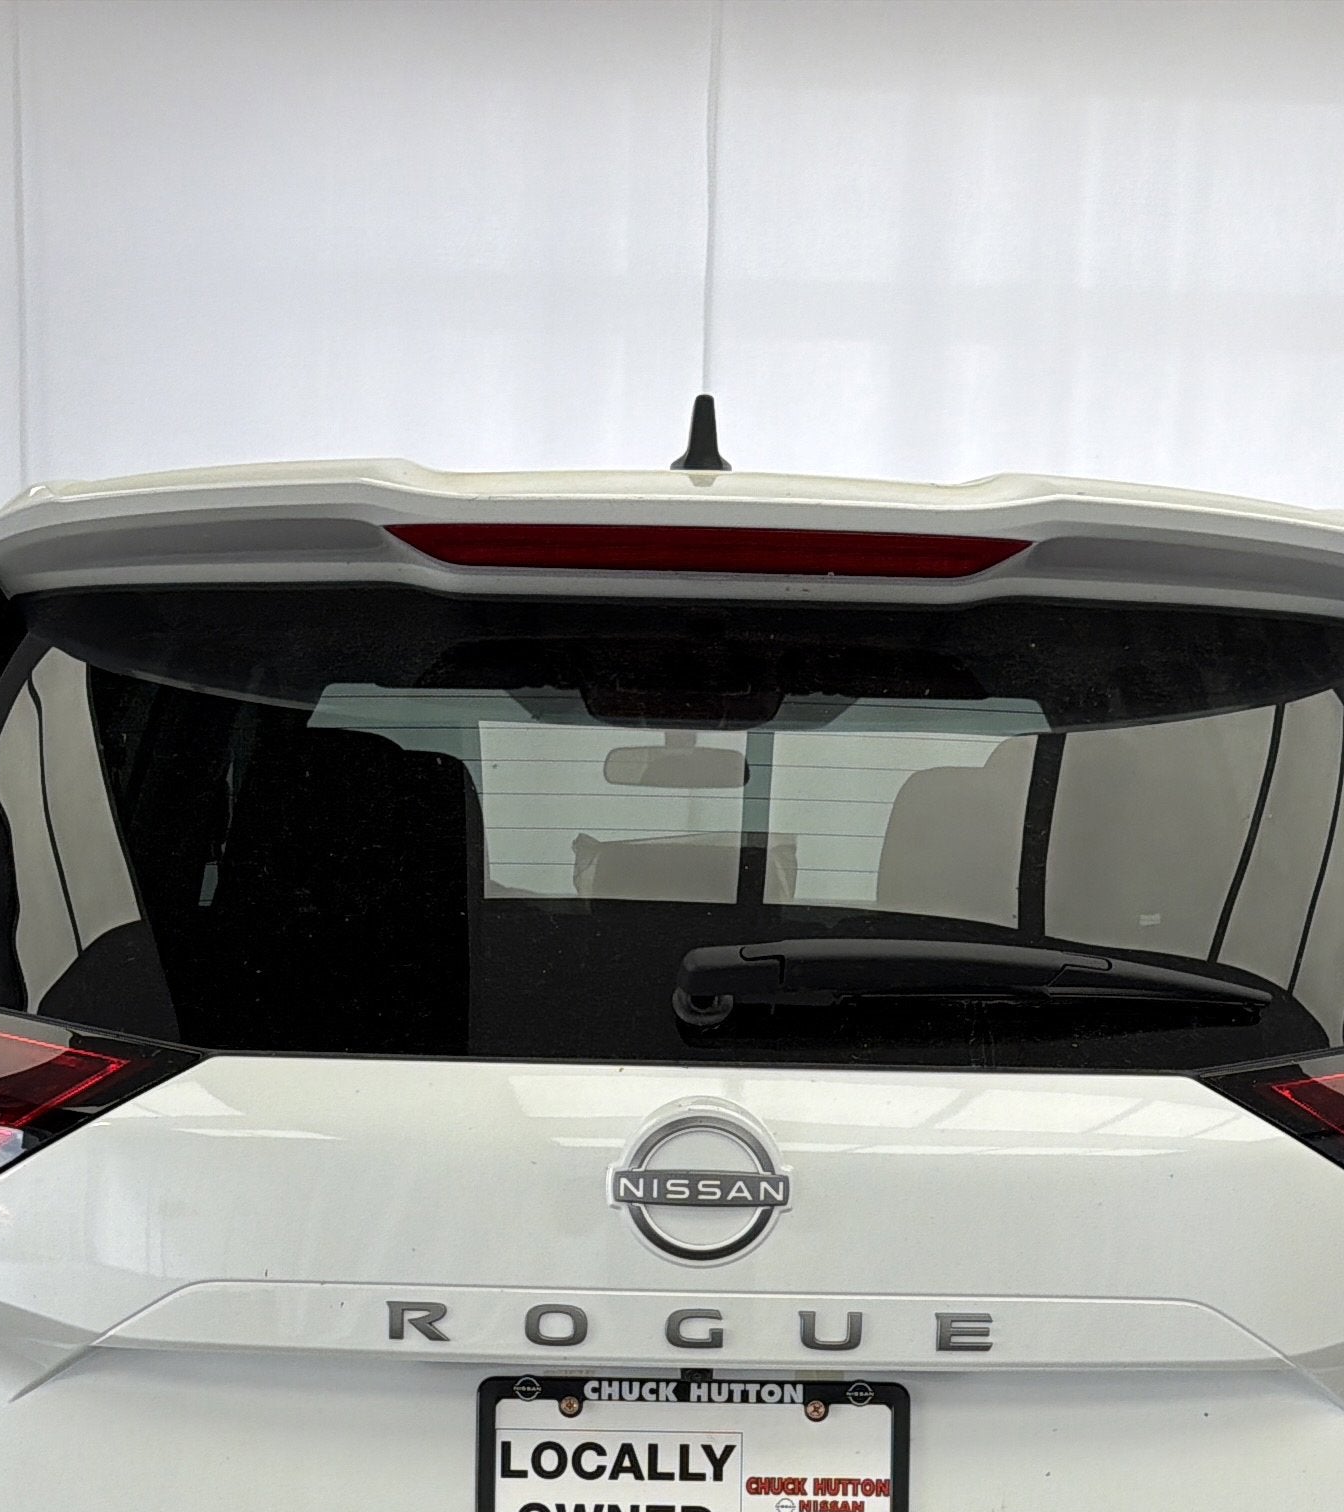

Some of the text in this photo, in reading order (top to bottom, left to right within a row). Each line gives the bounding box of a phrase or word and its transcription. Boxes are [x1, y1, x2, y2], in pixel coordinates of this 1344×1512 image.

[618, 1174, 785, 1202] NISSAN
[386, 1300, 994, 1351] ROGUE
[583, 1380, 804, 1404] CHUCK HUTTON
[500, 1440, 737, 1482] LOCALLY
[746, 1476, 891, 1497] CHUCK HUTTON
